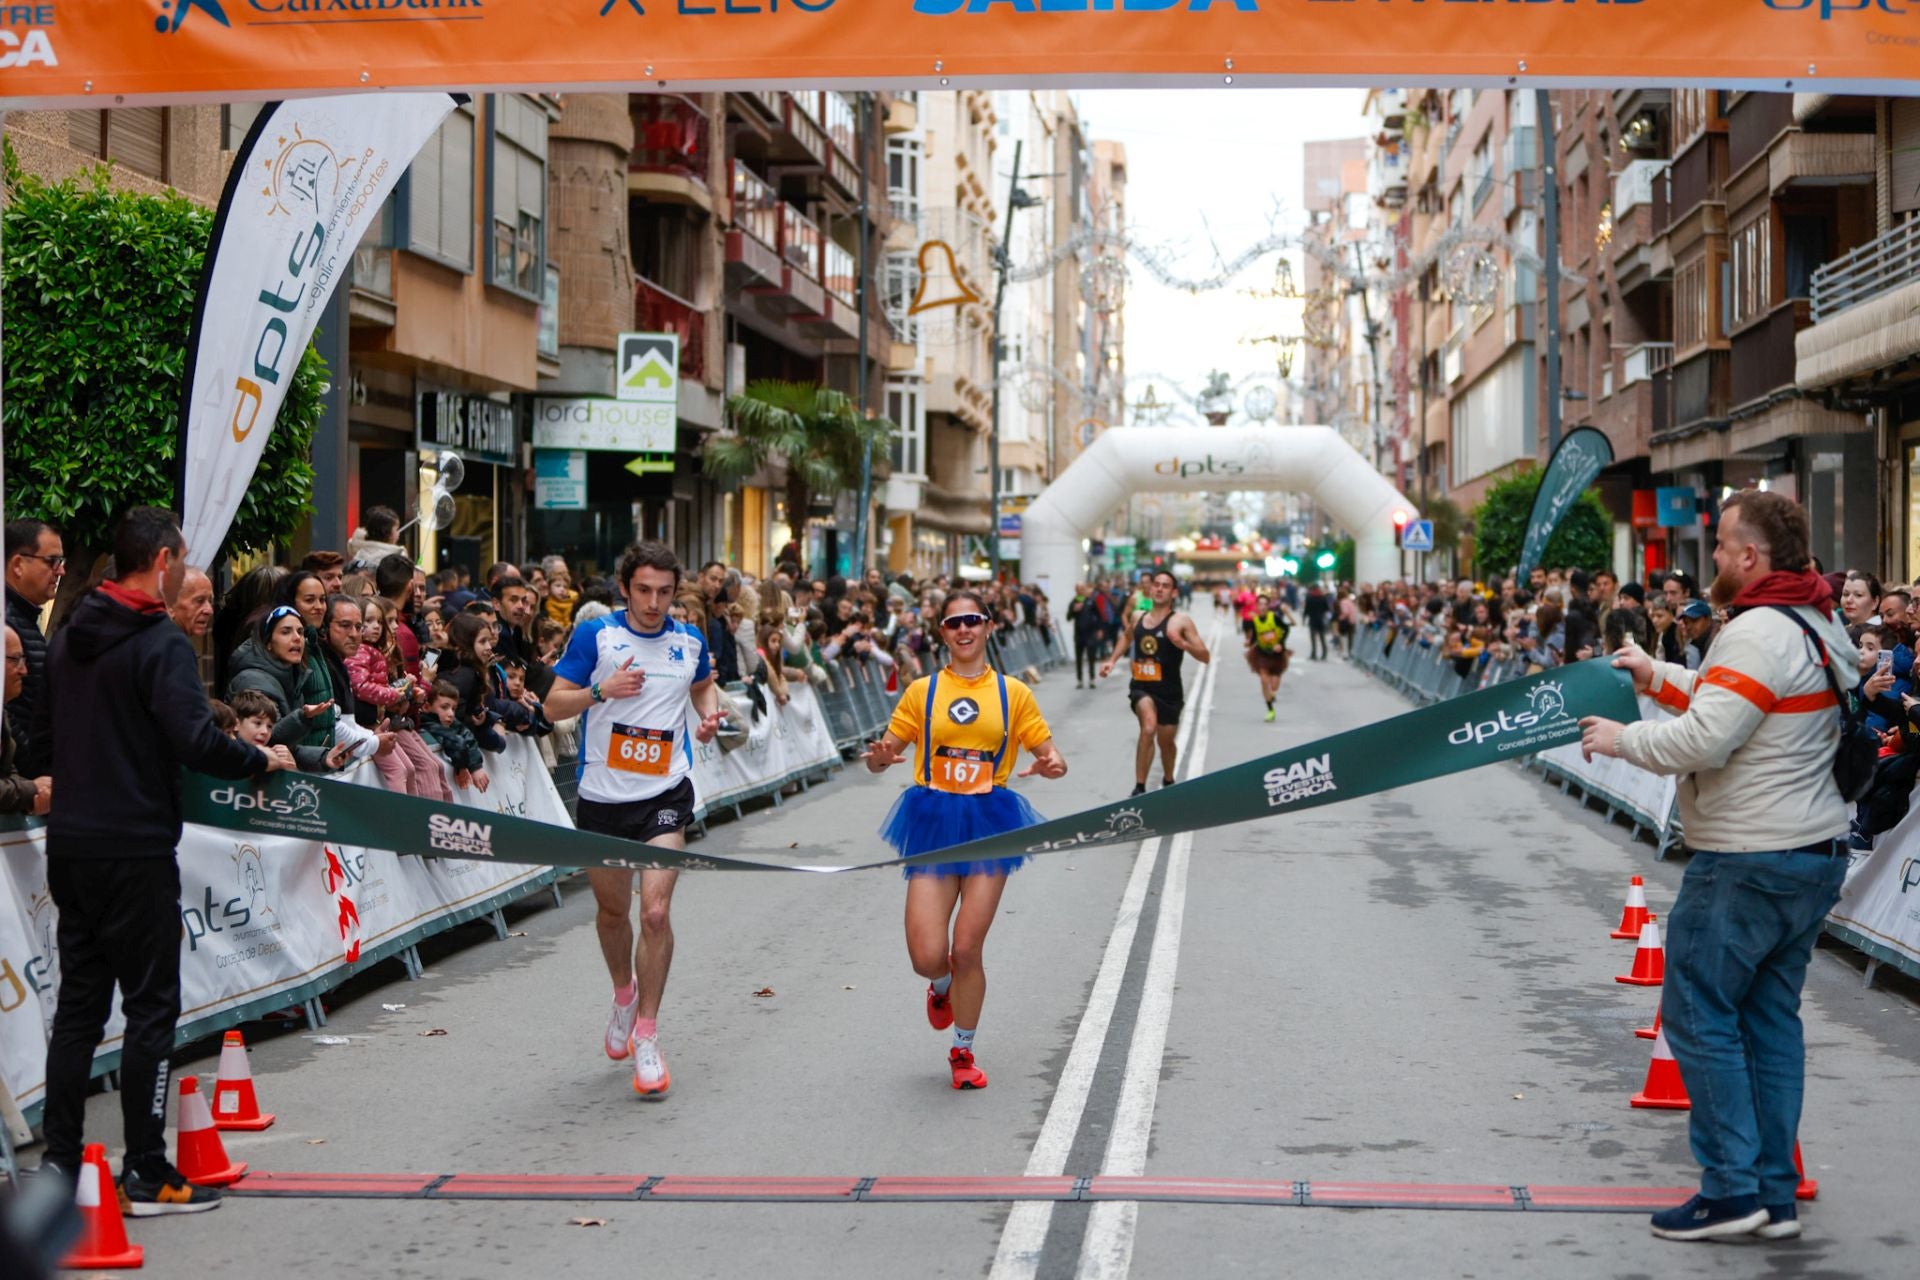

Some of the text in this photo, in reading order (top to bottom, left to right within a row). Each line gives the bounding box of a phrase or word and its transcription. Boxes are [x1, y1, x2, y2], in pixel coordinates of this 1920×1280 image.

[231, 220, 326, 444] dpts
[540, 400, 672, 426] lordhouse
[1154, 454, 1245, 479] dpts
[1448, 710, 1539, 745] dpts
[620, 739, 662, 764] 689
[943, 760, 981, 784] 167
[1264, 752, 1331, 790] SAN
[1267, 771, 1334, 797] SILVESTRE
[209, 786, 294, 815] dpts
[1267, 779, 1338, 807] LORCA
[427, 813, 493, 843] SAN
[430, 830, 493, 849] SILVESTRE
[429, 836, 496, 858] LORCA
[182, 885, 250, 952] pts
